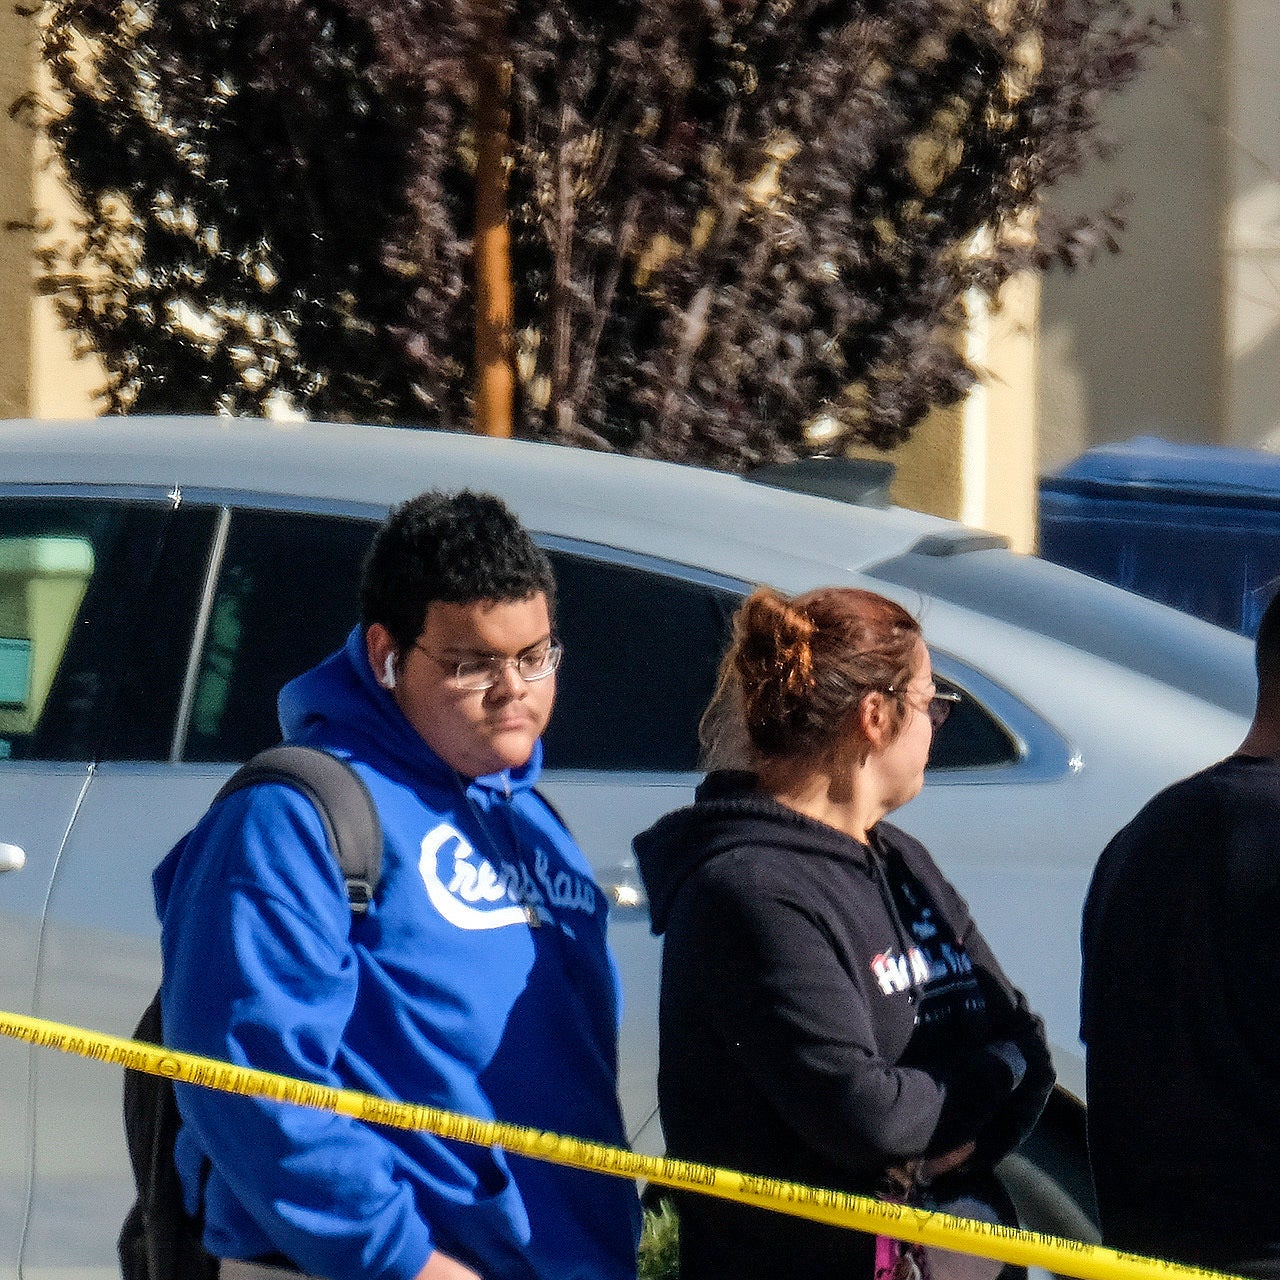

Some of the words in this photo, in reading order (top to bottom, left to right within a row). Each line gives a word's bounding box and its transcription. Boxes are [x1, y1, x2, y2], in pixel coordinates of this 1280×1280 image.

[67, 1036, 84, 1054] DO
[87, 1040, 110, 1062] NOT
[360, 1094, 416, 1131] SHERIFFS
[739, 1172, 795, 1203] SHERIFFS
